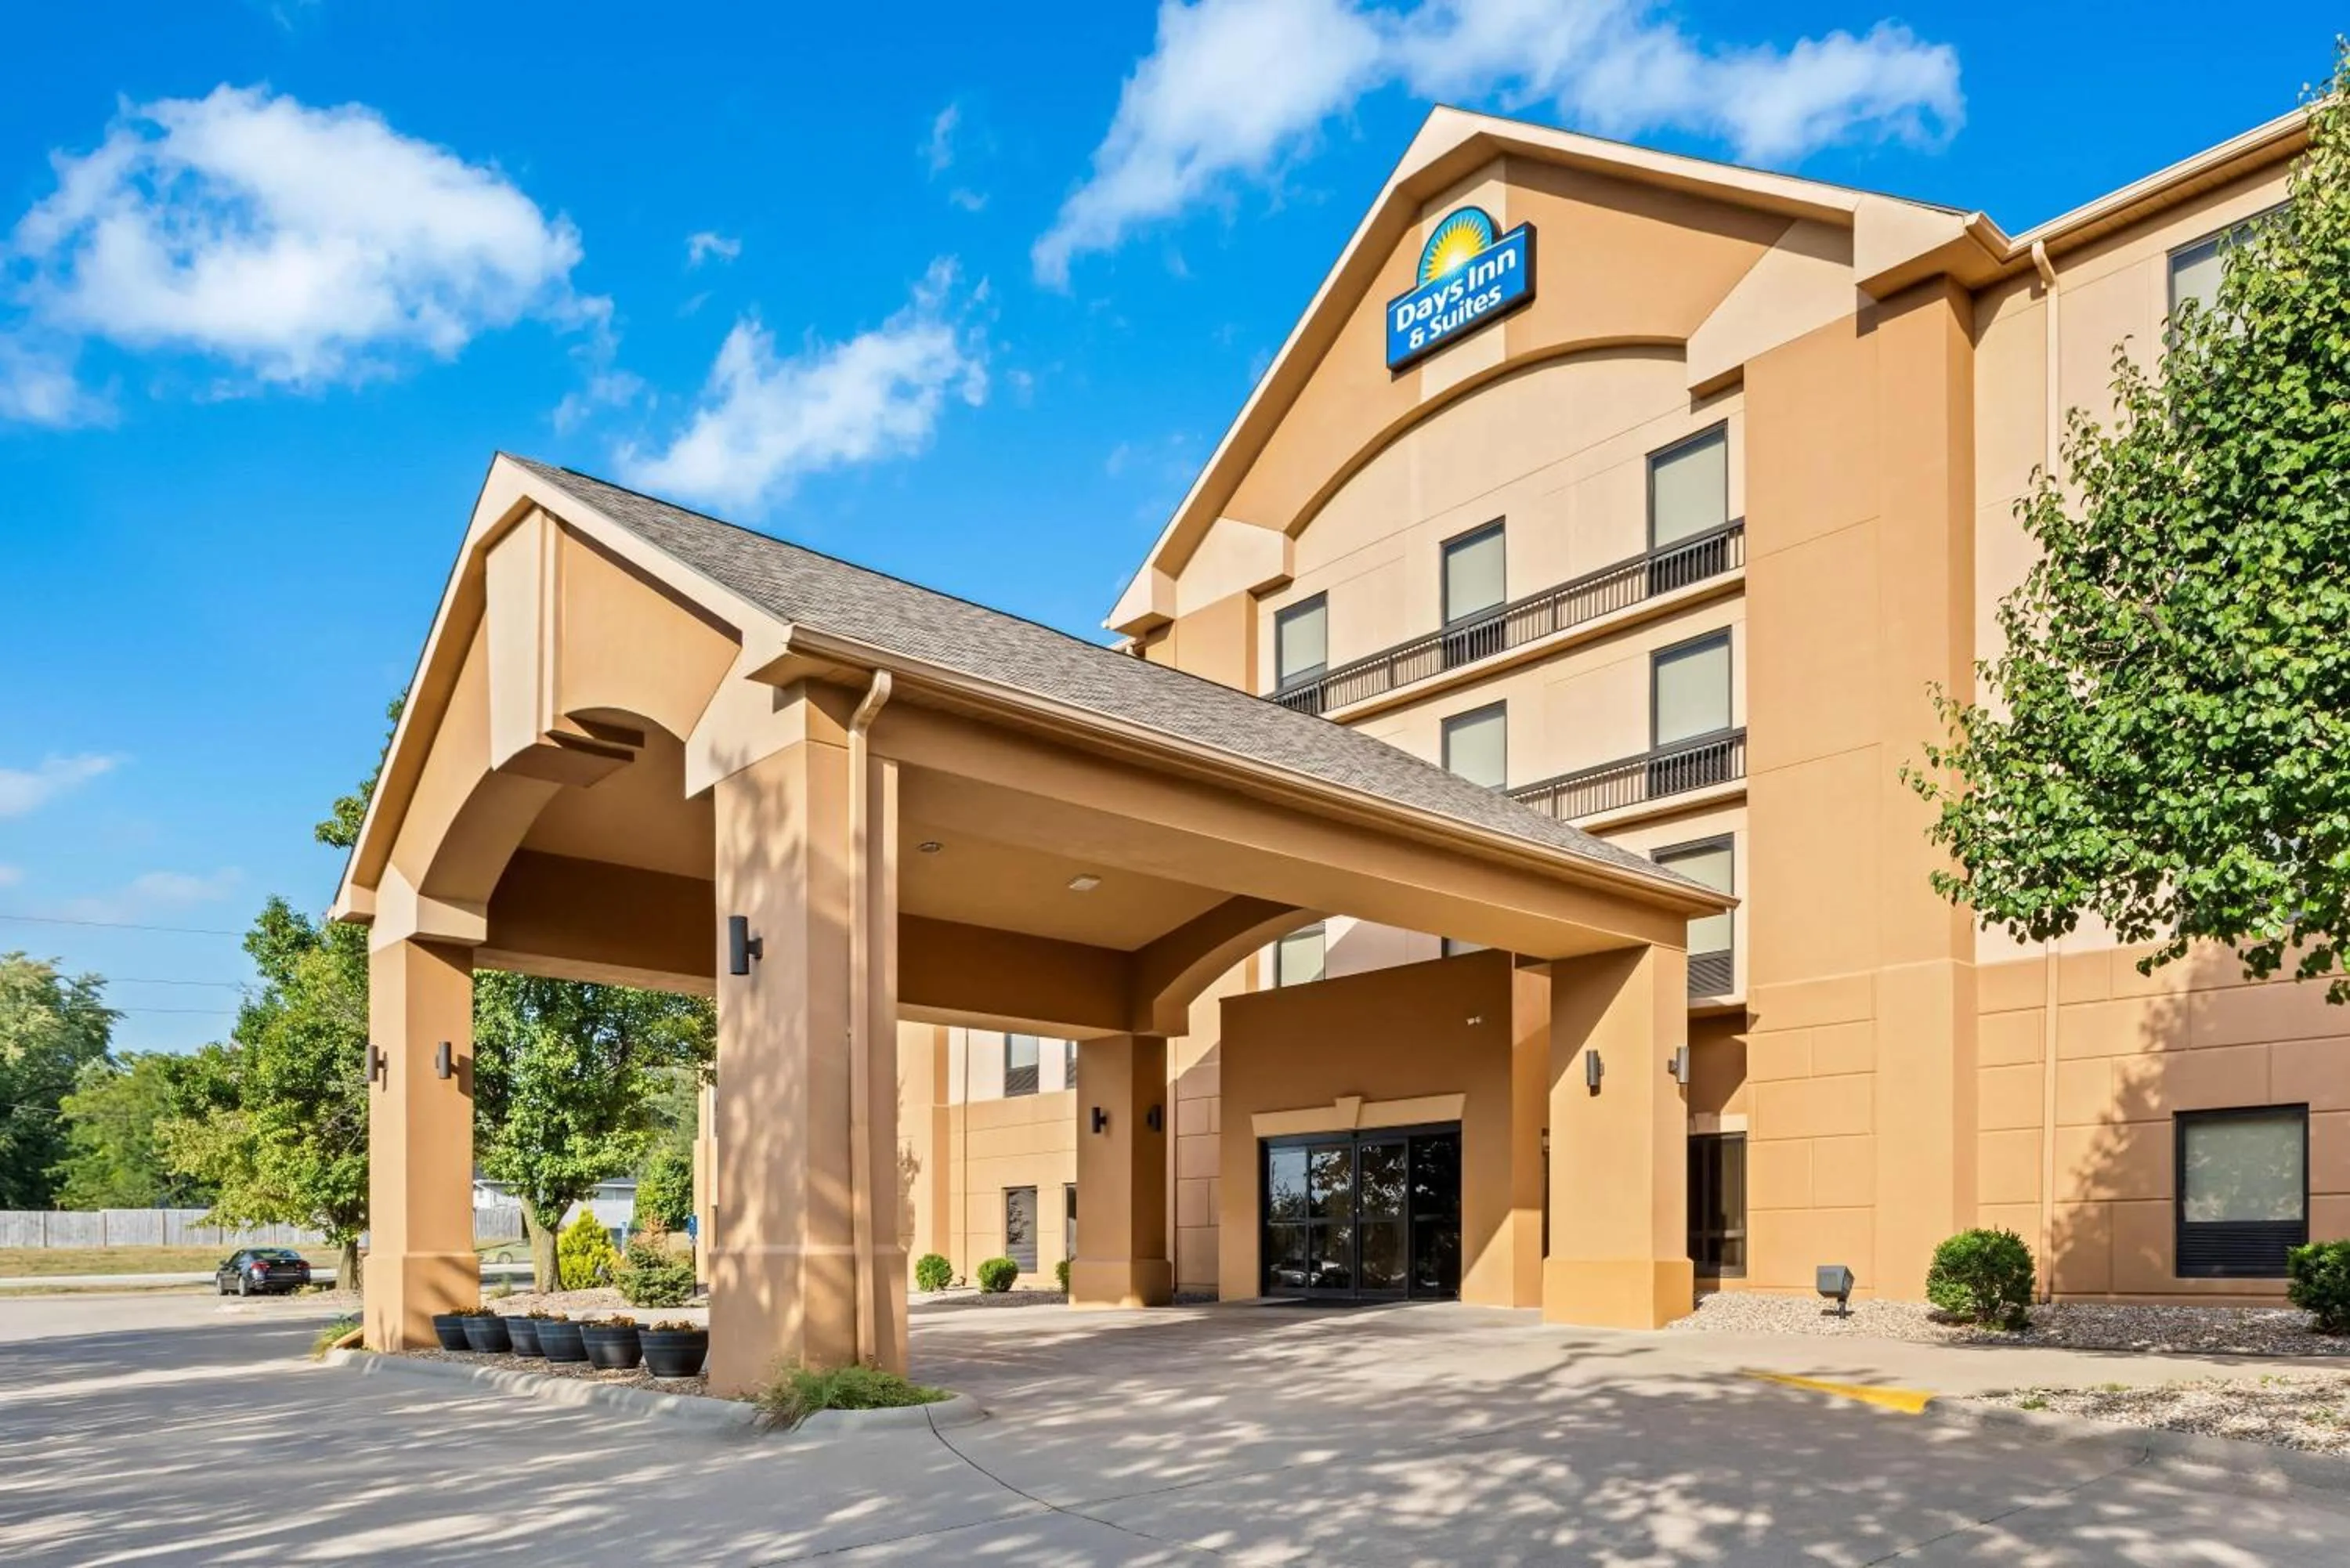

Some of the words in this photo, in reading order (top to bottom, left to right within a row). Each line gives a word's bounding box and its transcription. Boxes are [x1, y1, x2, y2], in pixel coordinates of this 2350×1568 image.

[1397, 278, 1463, 332] Days
[1469, 248, 1516, 291] Inn
[1409, 327, 1425, 349] &
[1430, 285, 1502, 339] Suites
